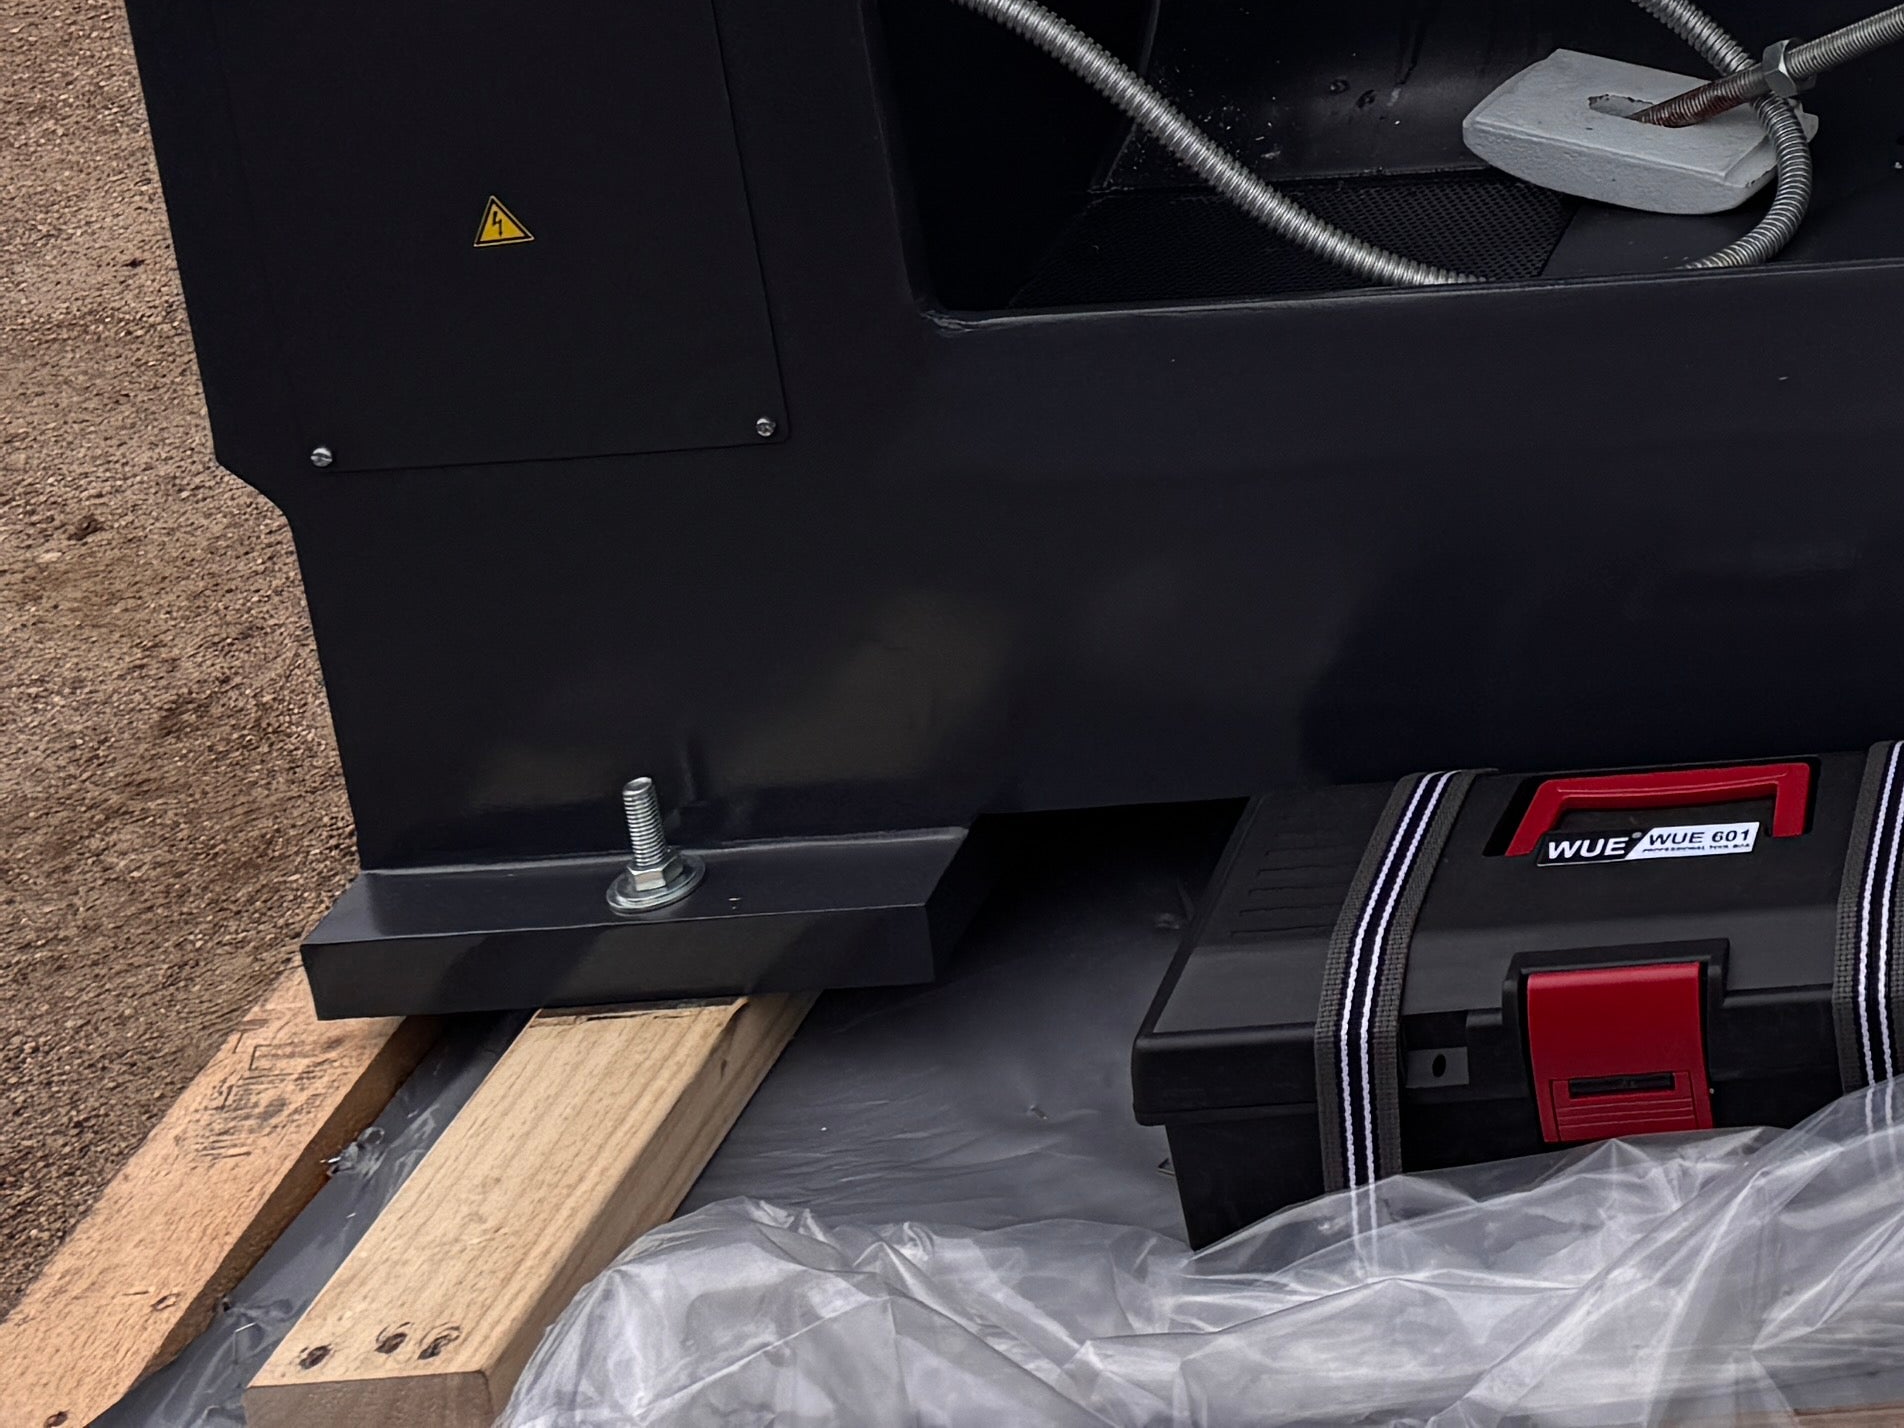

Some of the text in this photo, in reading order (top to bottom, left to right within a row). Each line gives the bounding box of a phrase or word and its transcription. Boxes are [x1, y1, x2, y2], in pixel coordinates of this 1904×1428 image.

[1650, 829, 1750, 845] WUE 601
[1548, 837, 1628, 859] WUE
